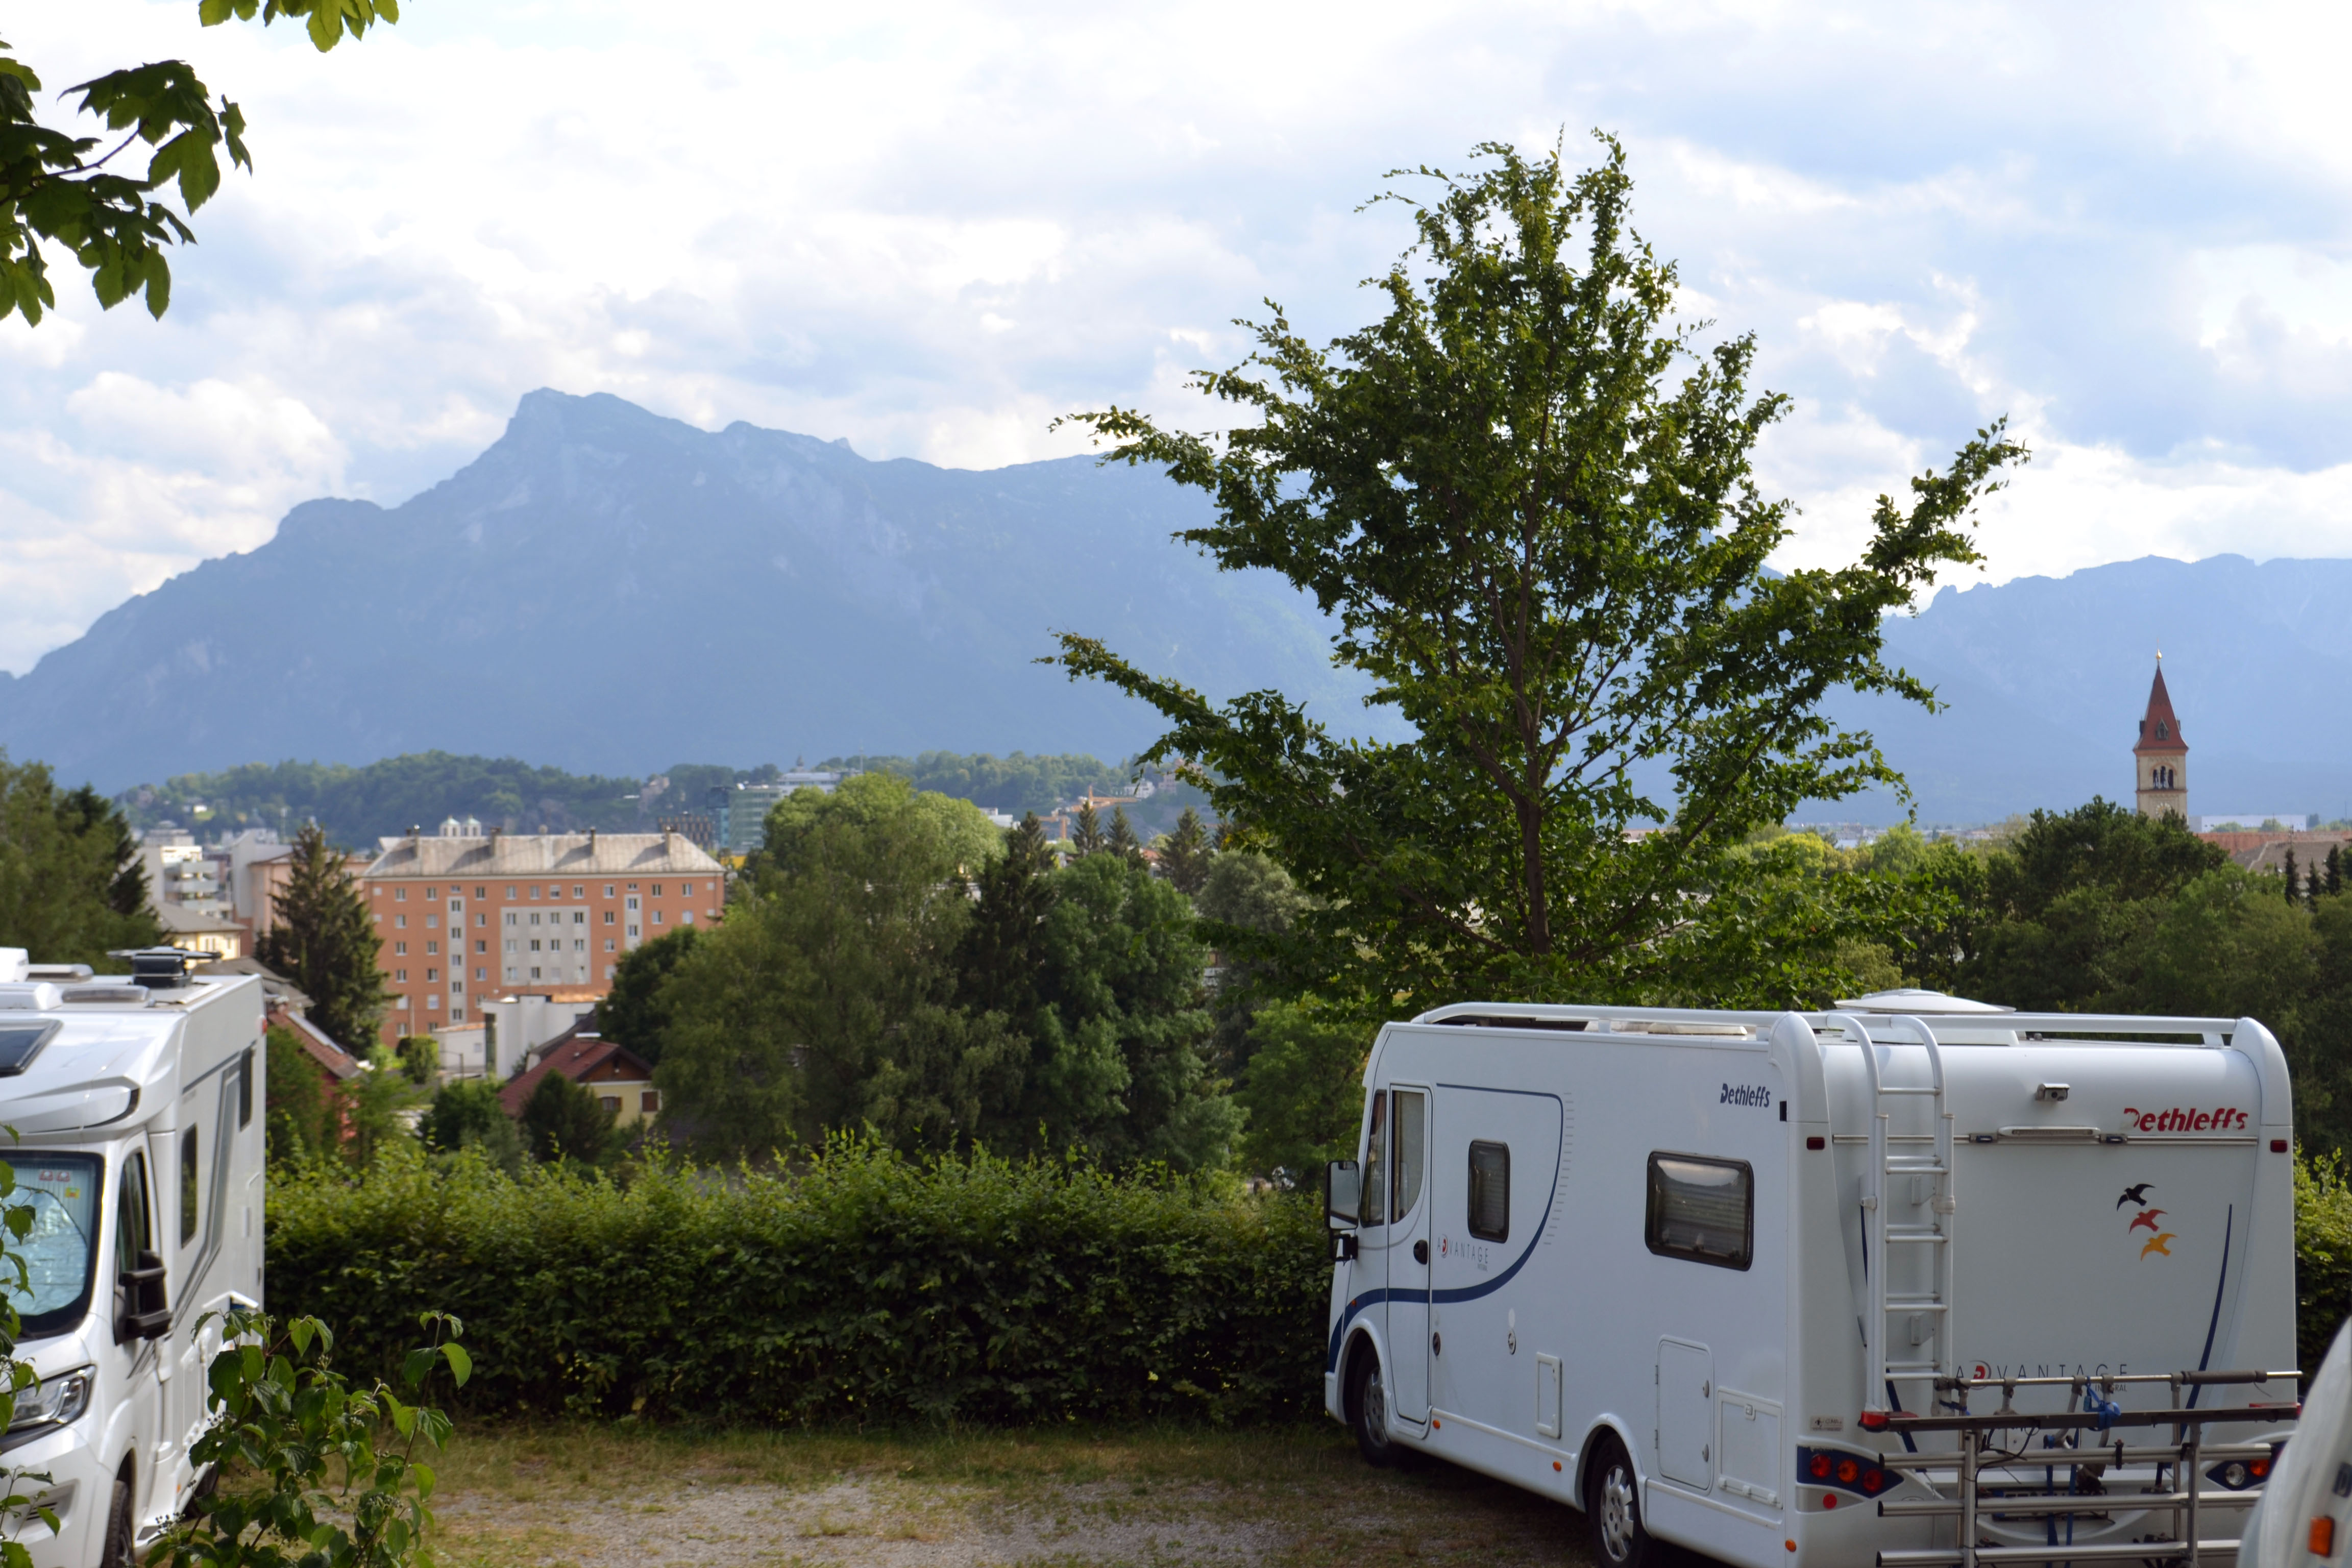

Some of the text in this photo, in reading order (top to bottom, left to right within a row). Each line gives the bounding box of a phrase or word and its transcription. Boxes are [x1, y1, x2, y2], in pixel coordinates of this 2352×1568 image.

[1720, 1083, 1771, 1108] Dethleffs
[1437, 1234, 1488, 1264] ADVANTAGE
[2095, 1384, 2127, 1392] INRAL
